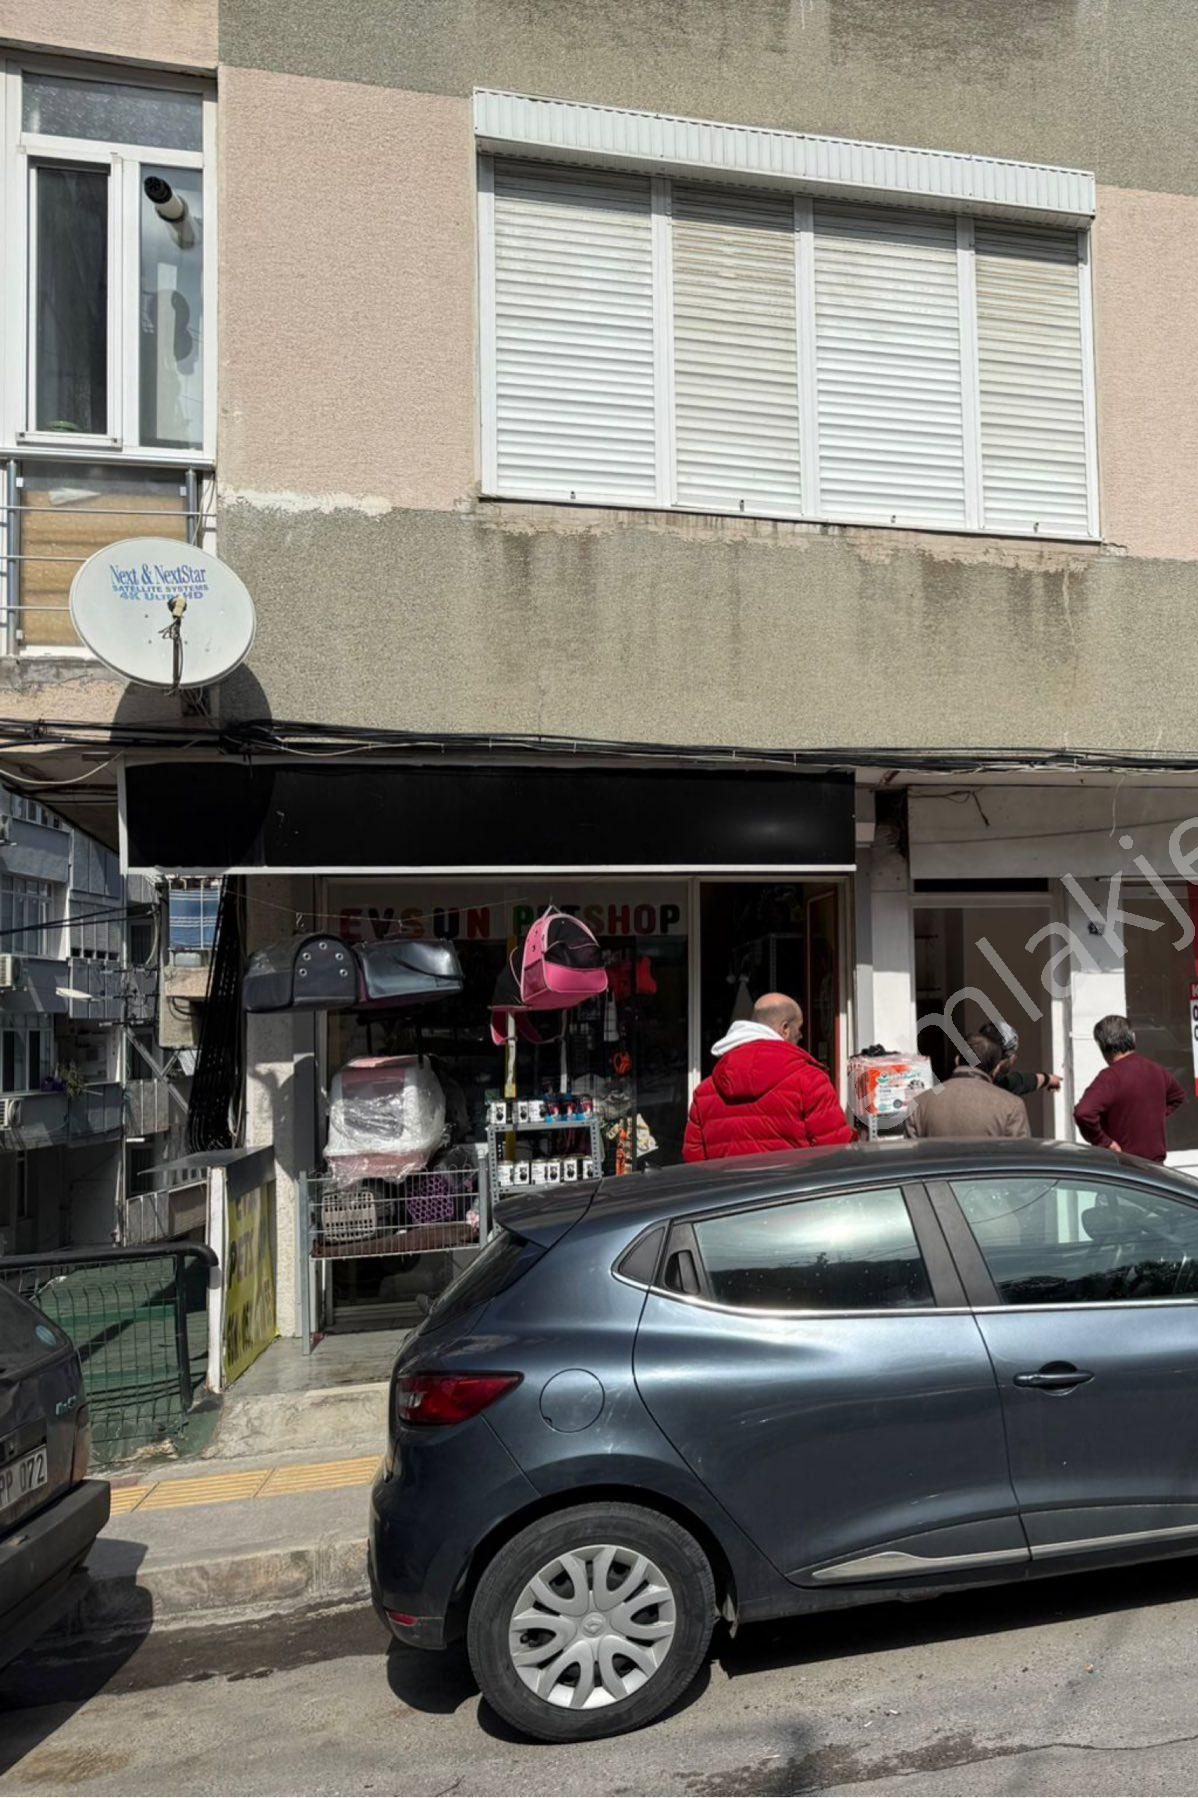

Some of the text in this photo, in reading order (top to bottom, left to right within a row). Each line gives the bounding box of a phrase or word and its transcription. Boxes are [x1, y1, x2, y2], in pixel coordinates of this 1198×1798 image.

[110, 563, 206, 585] Next & NextStar
[165, 584, 209, 592] SYSTEMS
[513, 904, 680, 936] PSHOP
[20, 1453, 45, 1492] 072
